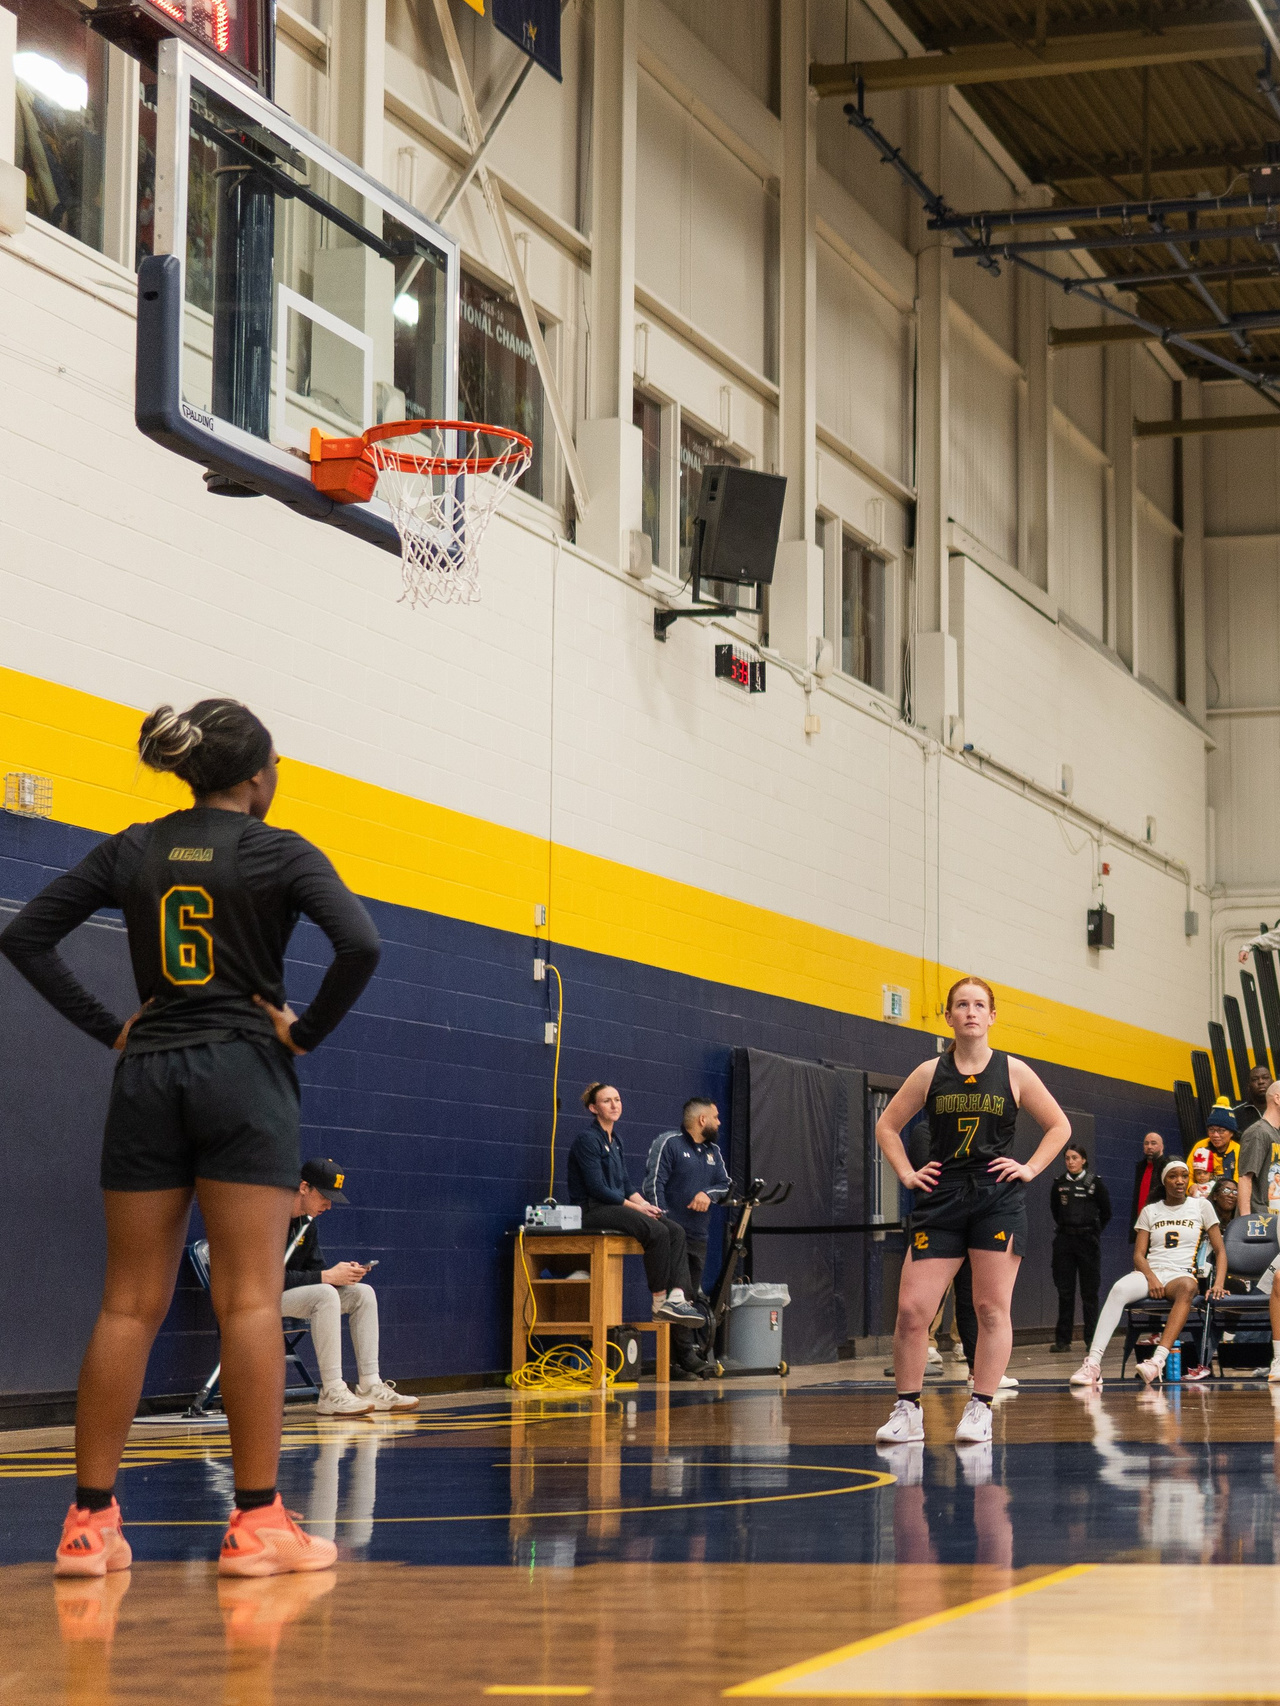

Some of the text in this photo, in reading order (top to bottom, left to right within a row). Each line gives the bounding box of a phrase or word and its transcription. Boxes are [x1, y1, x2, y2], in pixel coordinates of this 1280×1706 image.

[459, 299, 495, 339] TIONAL
[182, 404, 214, 431] SPALDING
[160, 885, 215, 985] 6
[935, 1093, 1005, 1116] DURHAM
[954, 1116, 980, 1159] 7
[1153, 1219, 1194, 1230] HUMBER
[1164, 1231, 1180, 1249] 6
